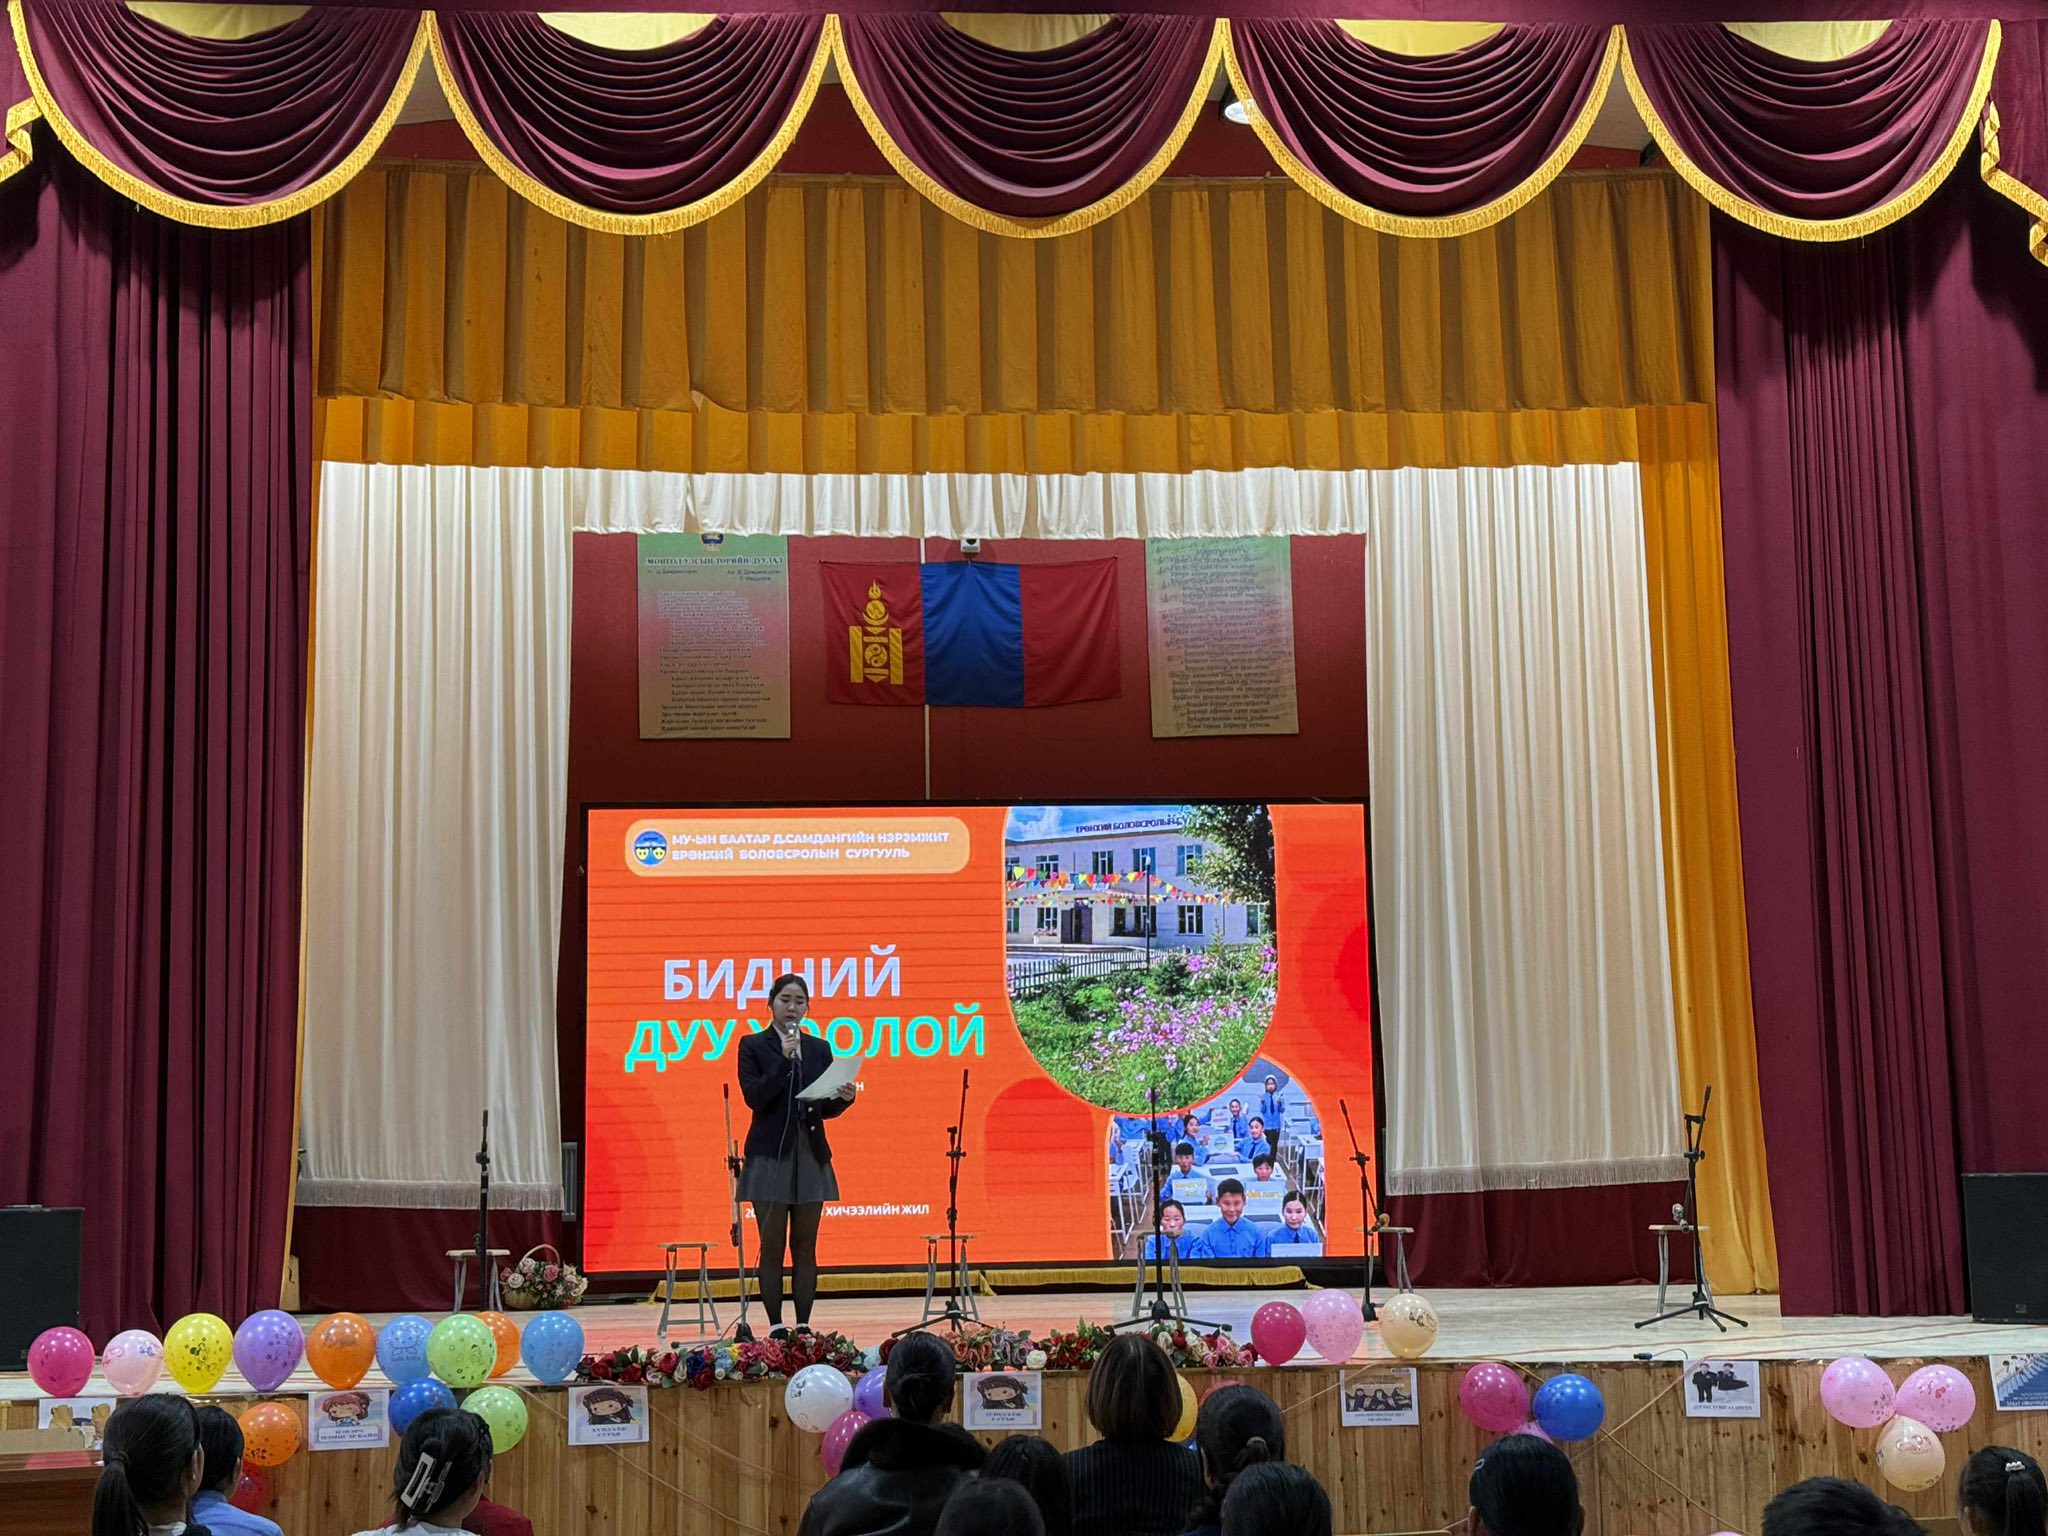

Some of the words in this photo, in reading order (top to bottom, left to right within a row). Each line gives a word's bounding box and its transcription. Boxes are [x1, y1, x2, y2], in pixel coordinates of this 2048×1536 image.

[671, 834, 717, 845] МУ-ЫН
[719, 833, 770, 845] БААТАР
[773, 831, 875, 845] Д.САМДАНГИЙН
[877, 832, 950, 843] НЭРЭМЖИТ
[671, 847, 734, 860] ЕРӨНХИЙ
[739, 848, 840, 860] БОЛОВСРОЛЫН
[845, 848, 911, 859] СУРГУУЛЬ
[624, 1017, 737, 1073] ДУУ
[826, 1202, 900, 1217] ХИЧЭЭЛИЙН
[901, 1204, 930, 1215] ЖИЛ
